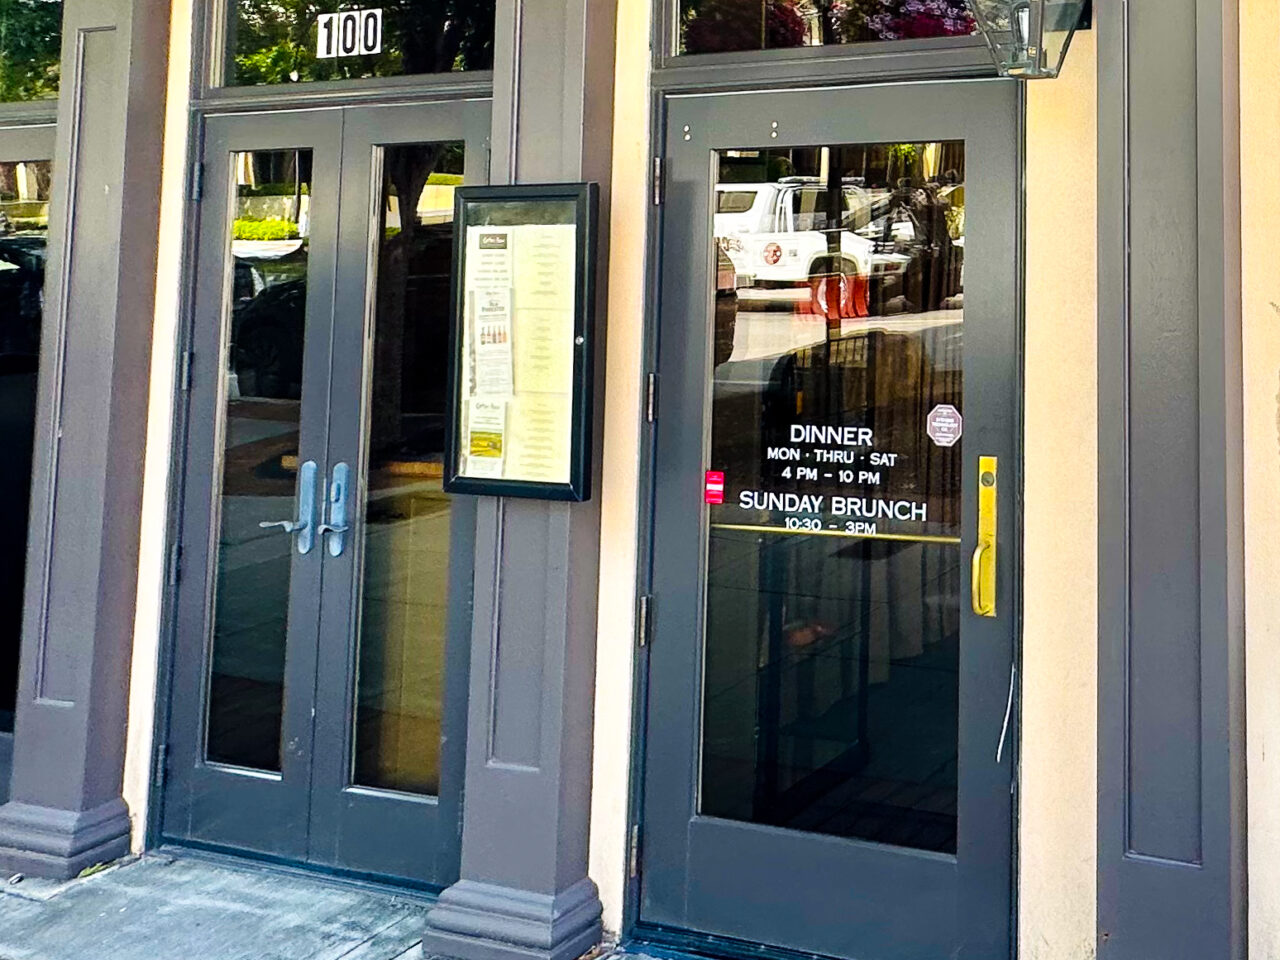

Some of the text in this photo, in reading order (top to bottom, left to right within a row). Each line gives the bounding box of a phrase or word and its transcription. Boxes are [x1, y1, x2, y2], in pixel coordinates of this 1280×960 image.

[323, 11, 378, 55] 100
[790, 424, 873, 446] DINNER
[767, 447, 800, 461] MON
[813, 449, 854, 464] THRU
[869, 452, 898, 467] SAT
[781, 466, 791, 479] 4
[796, 467, 818, 481] PM
[838, 470, 854, 483] 10
[858, 471, 880, 485] PM
[739, 490, 927, 522] SUNDAY BRUNCH
[845, 521, 877, 535] 3PM
